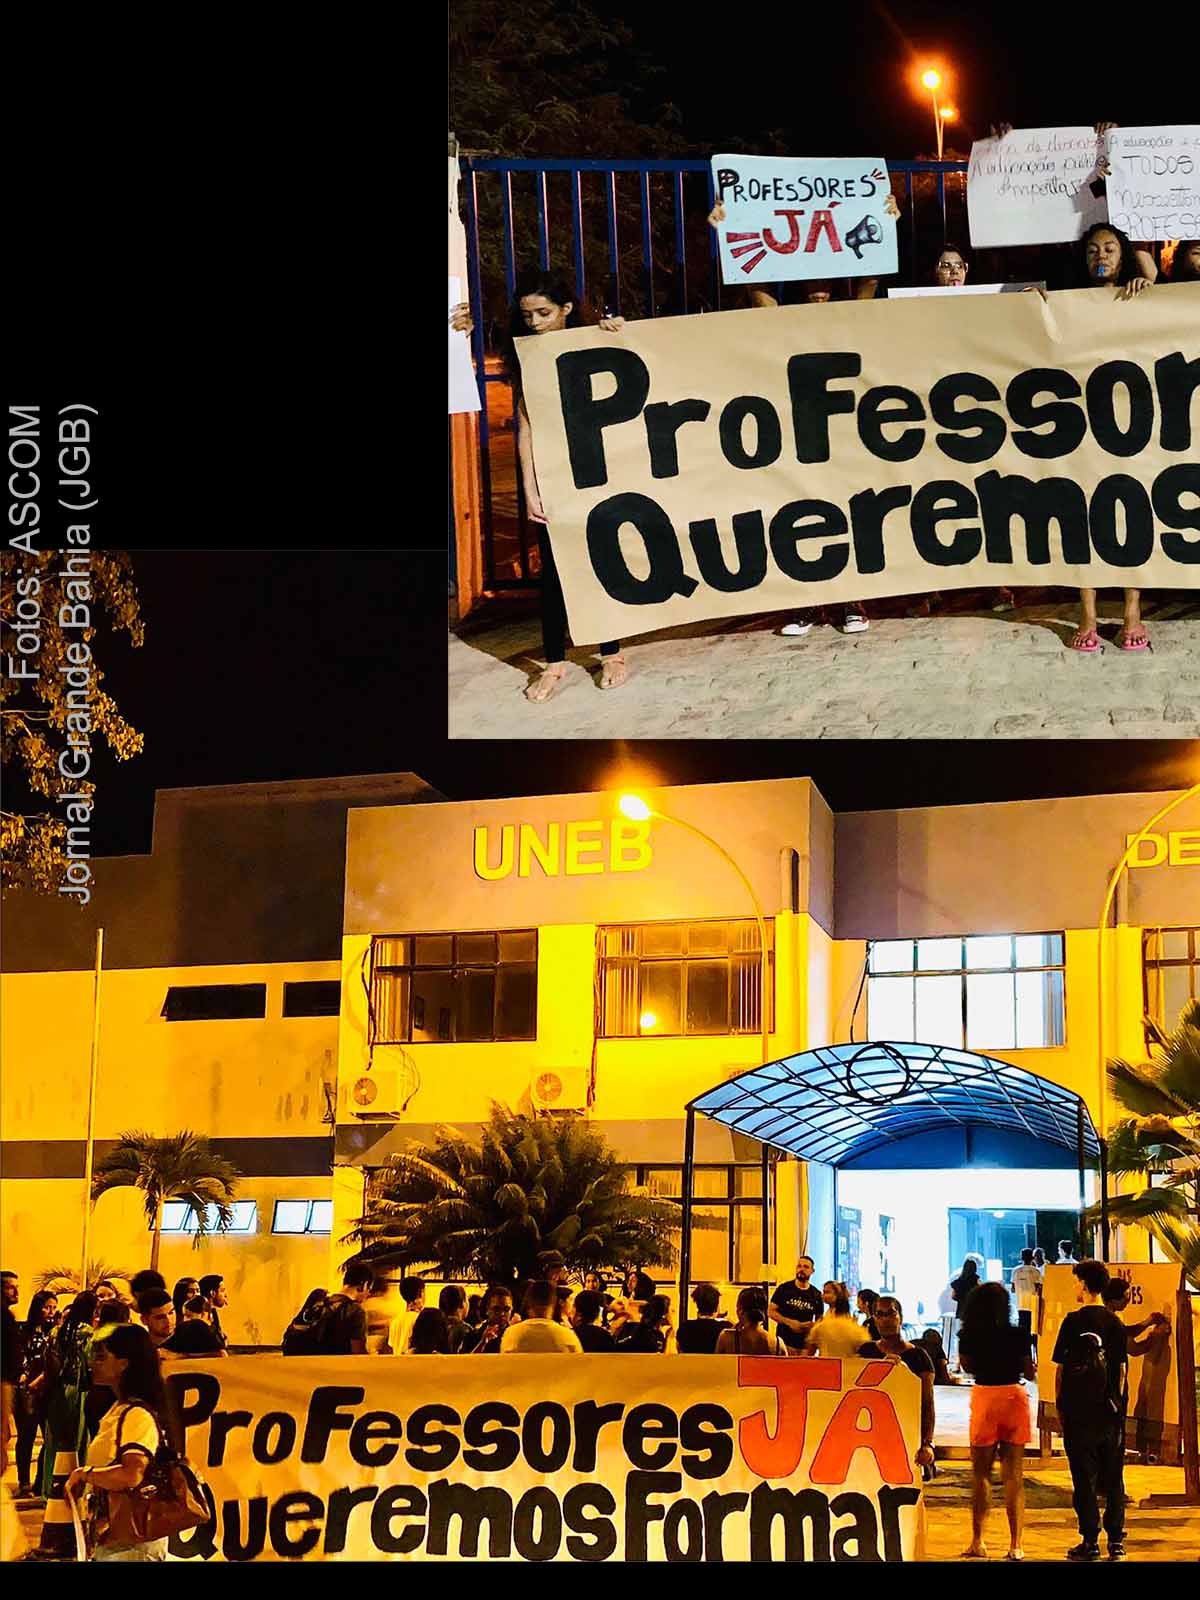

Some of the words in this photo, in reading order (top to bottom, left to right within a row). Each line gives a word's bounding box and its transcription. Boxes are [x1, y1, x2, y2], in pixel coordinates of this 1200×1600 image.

[716, 168, 877, 203] PROFESSORES
[1122, 154, 1194, 176] TODOS
[762, 201, 843, 255] JÁ
[473, 820, 654, 881] UNEB
[737, 1355, 914, 1485] JÁ
[625, 1470, 921, 1561] Formar
